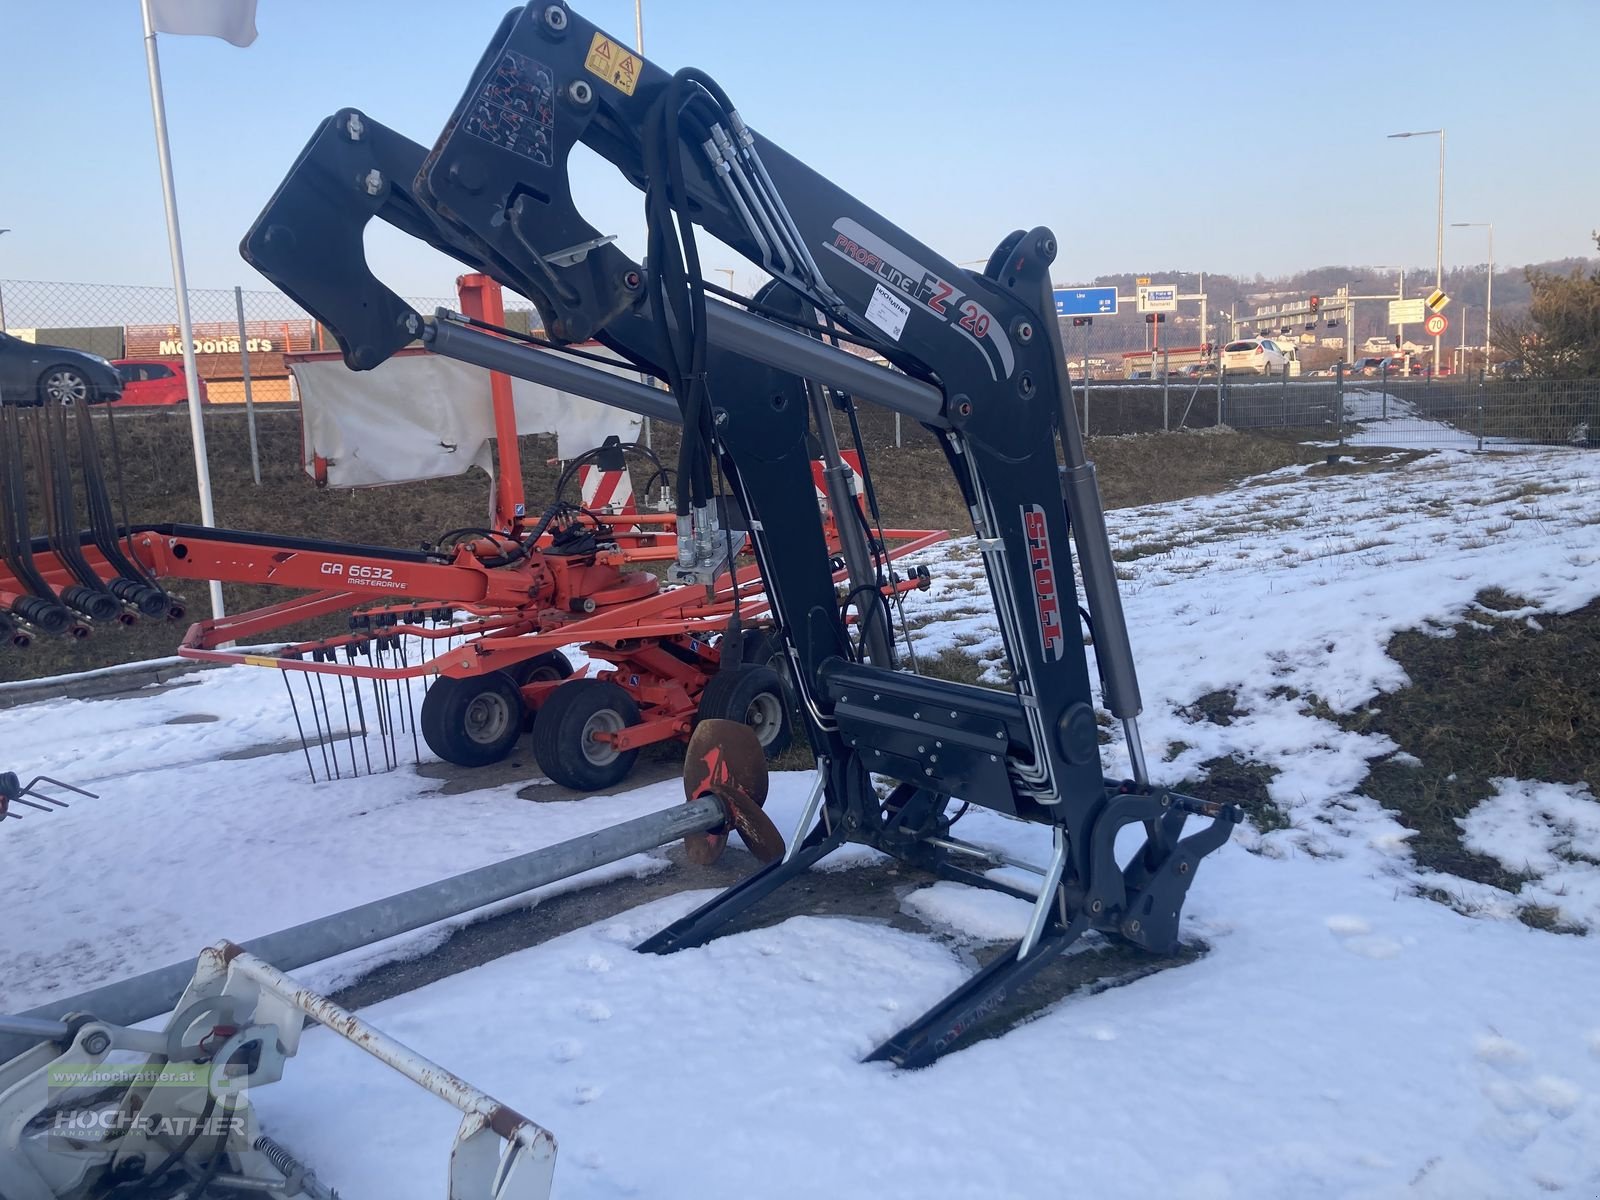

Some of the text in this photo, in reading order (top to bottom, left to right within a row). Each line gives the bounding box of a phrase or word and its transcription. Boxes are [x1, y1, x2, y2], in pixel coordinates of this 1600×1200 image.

[914, 271, 954, 315] FZ
[959, 304, 990, 338] 20
[1431, 320, 1442, 330] 70
[159, 338, 273, 355] McDonad's
[320, 562, 393, 580] GA 6632
[347, 577, 407, 589] MASTERDRIVE
[1025, 512, 1062, 649] STOLL
